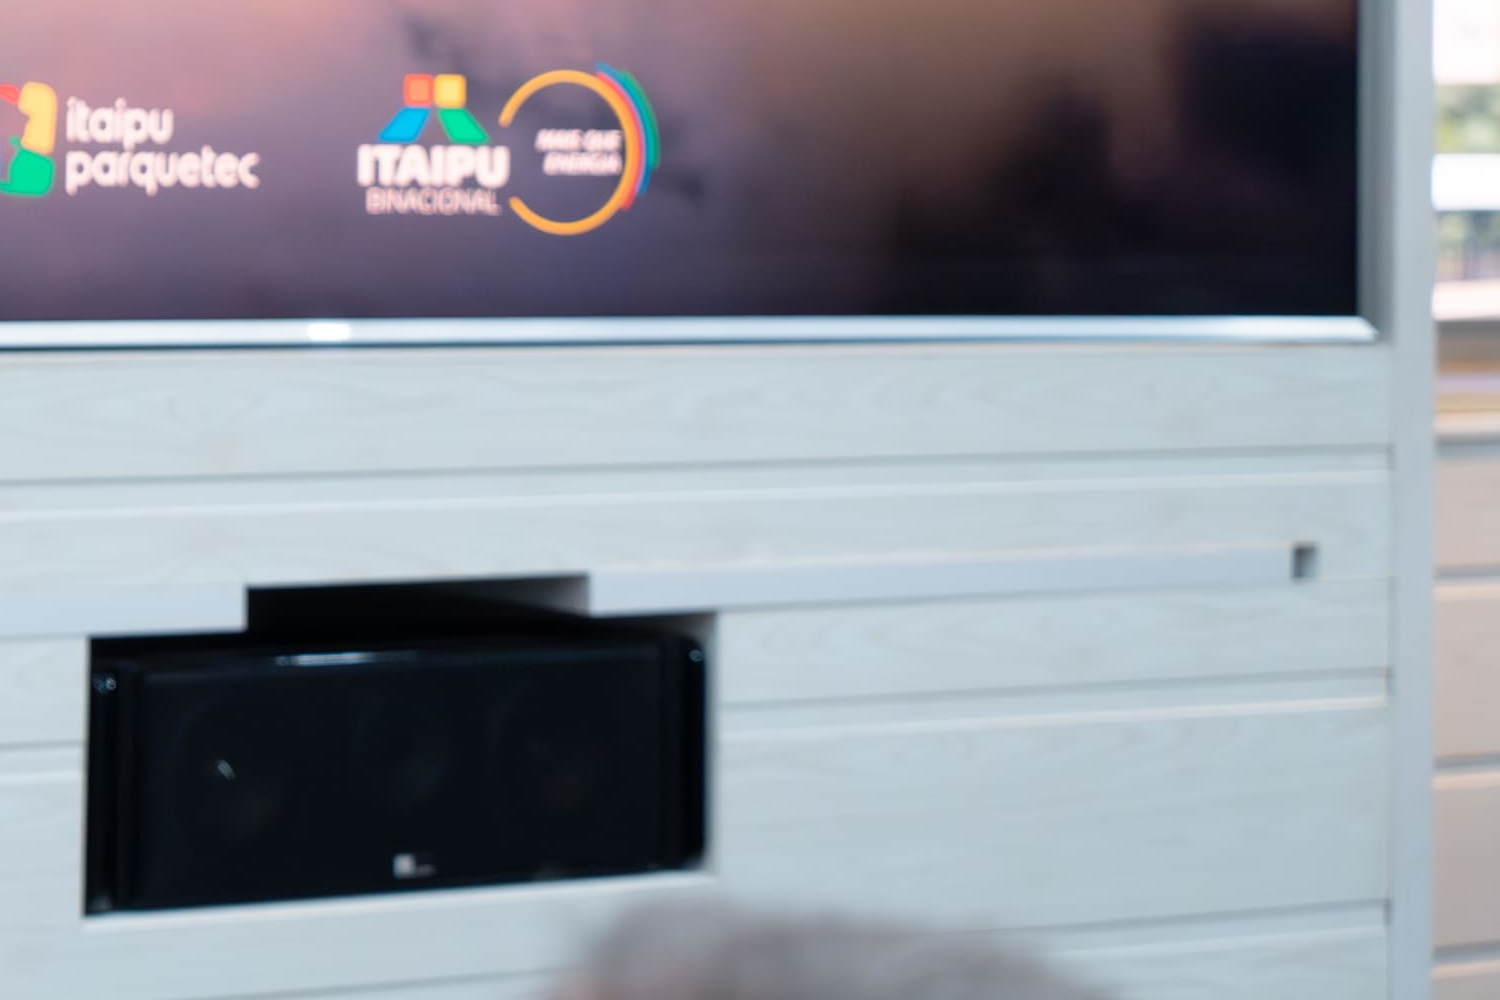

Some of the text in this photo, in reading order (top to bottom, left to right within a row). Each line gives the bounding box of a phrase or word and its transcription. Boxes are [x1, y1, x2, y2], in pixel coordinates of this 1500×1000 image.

[65, 97, 174, 150] itaipu
[65, 145, 260, 197] parquetec
[357, 143, 510, 188] ITAIPU
[366, 187, 502, 215] BINACIONAL
